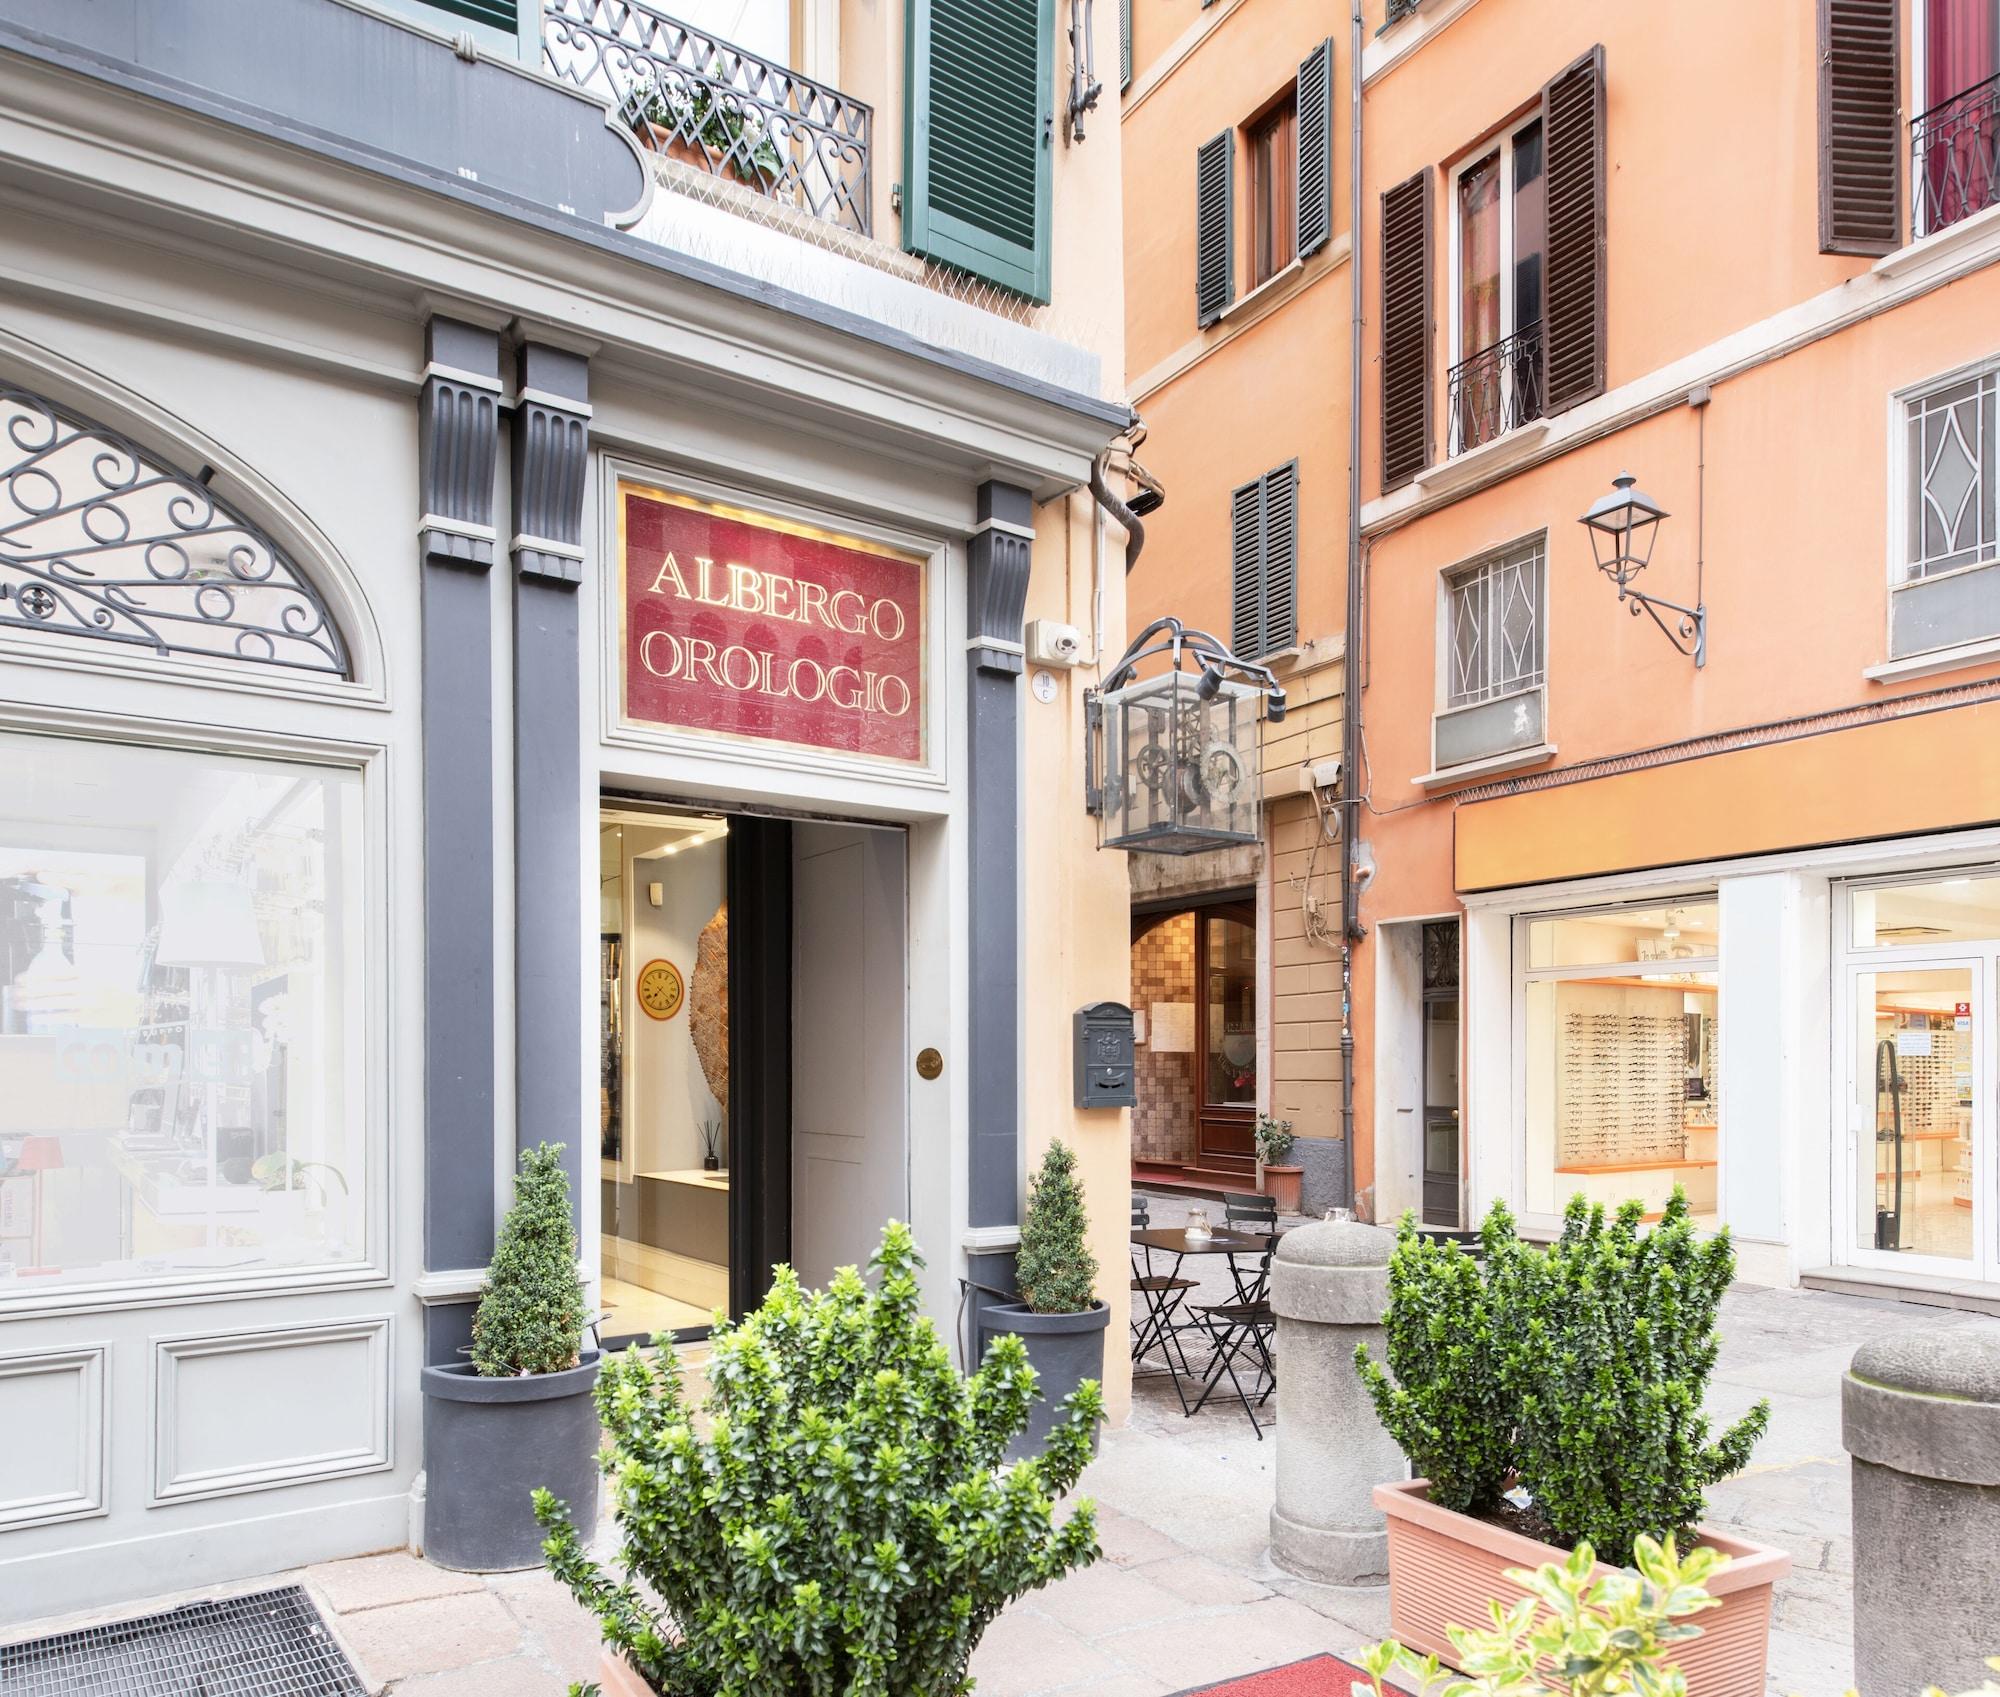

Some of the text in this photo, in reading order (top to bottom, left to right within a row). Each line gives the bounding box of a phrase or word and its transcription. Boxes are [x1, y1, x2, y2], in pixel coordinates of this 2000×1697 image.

[648, 551, 905, 641] ALBERGO
[640, 630, 911, 717] OROLOGIO
[1042, 689, 1049, 699] C
